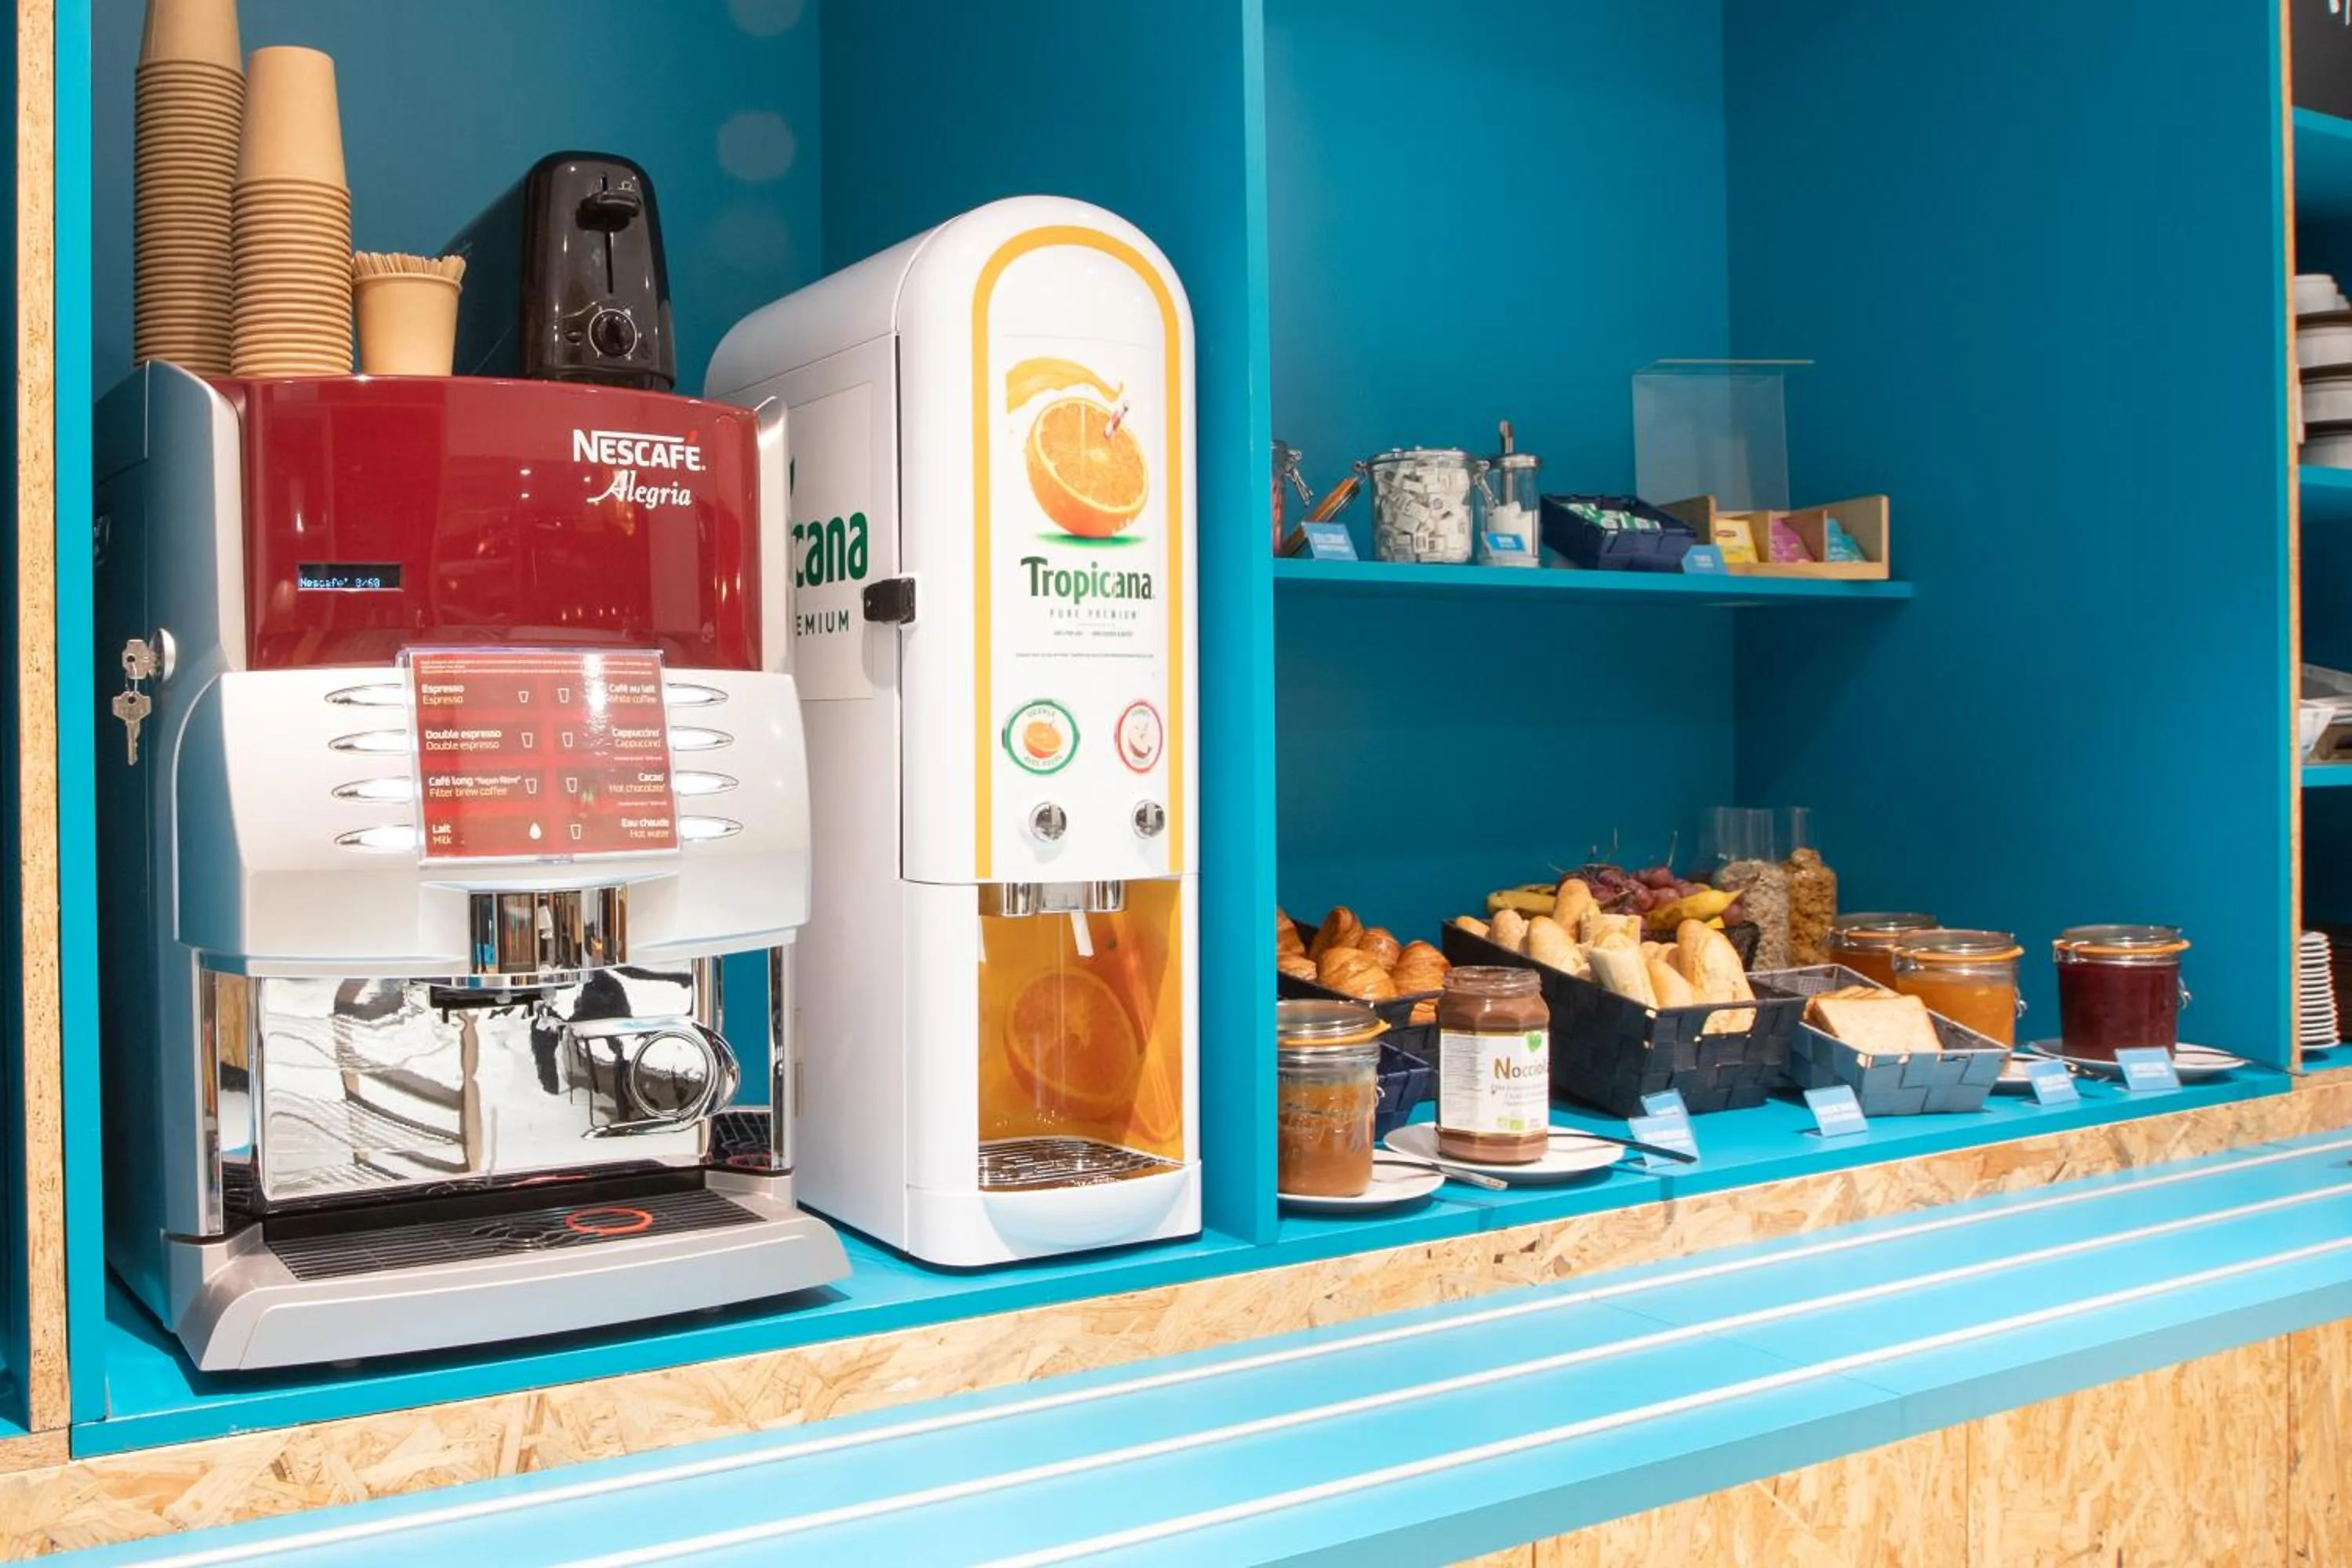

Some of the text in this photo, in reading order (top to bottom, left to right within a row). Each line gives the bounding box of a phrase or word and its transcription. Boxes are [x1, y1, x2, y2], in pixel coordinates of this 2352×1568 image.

[586, 470, 691, 509] Alegria
[1021, 556, 1155, 605] Tropicana
[422, 684, 464, 695] Espresso
[609, 684, 627, 693] Café
[641, 683, 655, 693] lait
[423, 695, 463, 706] Espresso
[632, 695, 657, 704] coffee
[426, 730, 502, 741] Double espresso
[426, 741, 500, 751] Double espresso
[429, 776, 449, 786] Café
[452, 775, 474, 787] long
[430, 786, 507, 797] Filter brew coffee
[609, 784, 625, 793] Hot
[621, 818, 669, 827] Eau chaude
[432, 824, 452, 833] Lait
[630, 829, 645, 838] Hot
[433, 835, 452, 845] Milk
